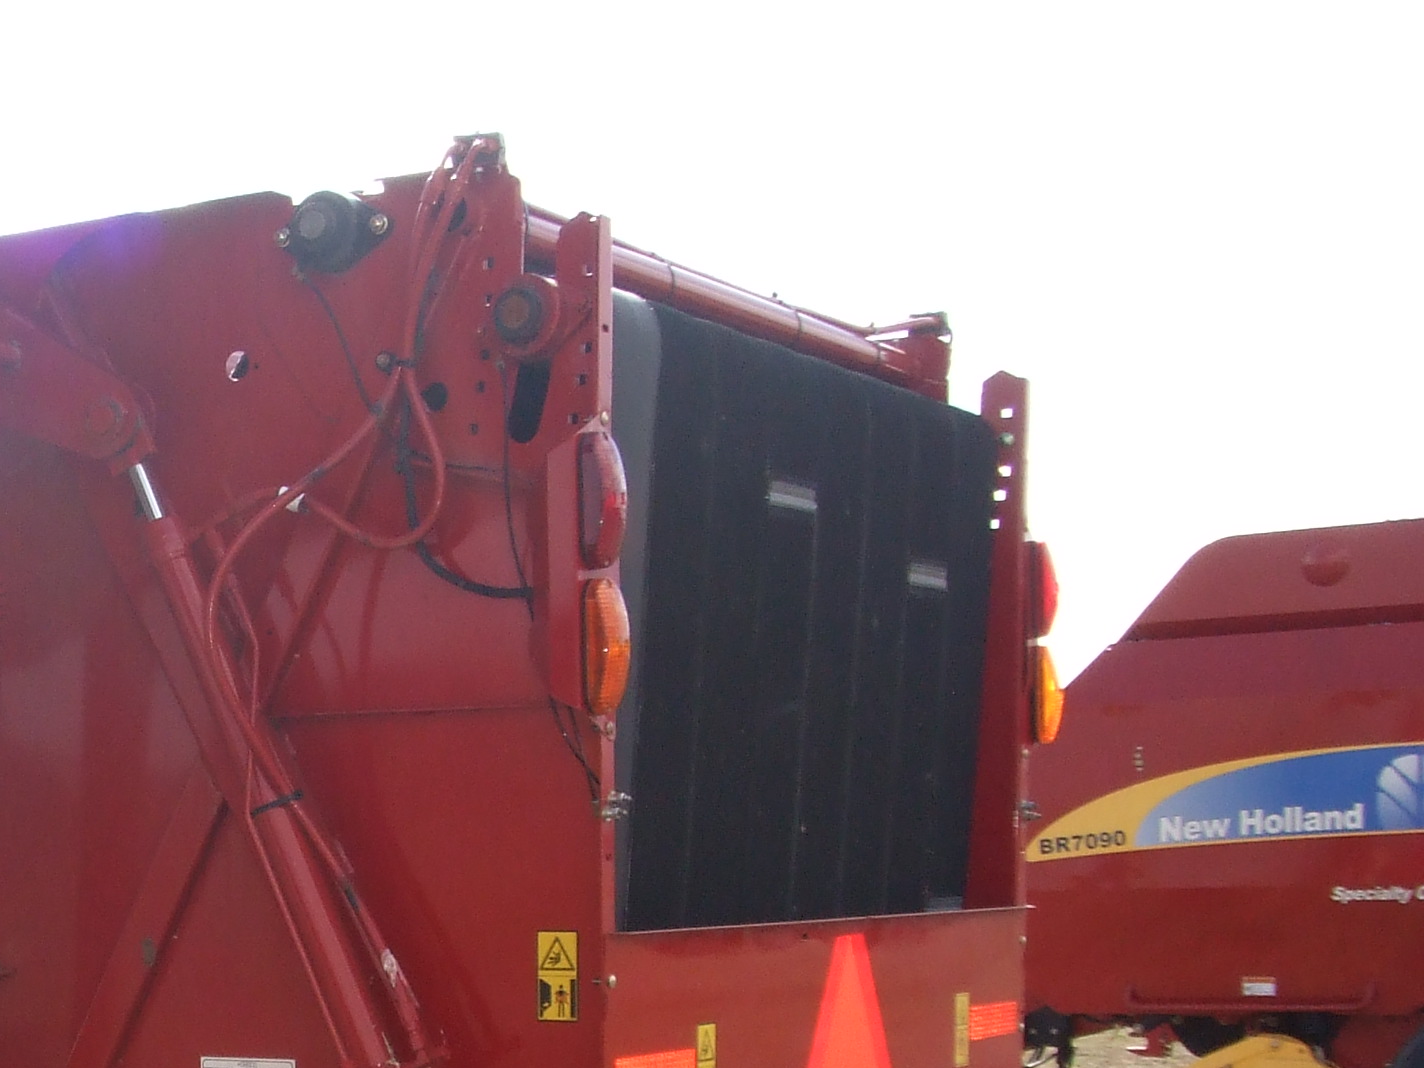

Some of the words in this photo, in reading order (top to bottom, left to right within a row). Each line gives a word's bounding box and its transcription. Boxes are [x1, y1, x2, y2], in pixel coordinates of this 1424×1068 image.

[1158, 816, 1230, 842] New
[1239, 803, 1365, 836] Holland
[1039, 830, 1126, 855] BR7090
[1330, 886, 1413, 904] Specialty
